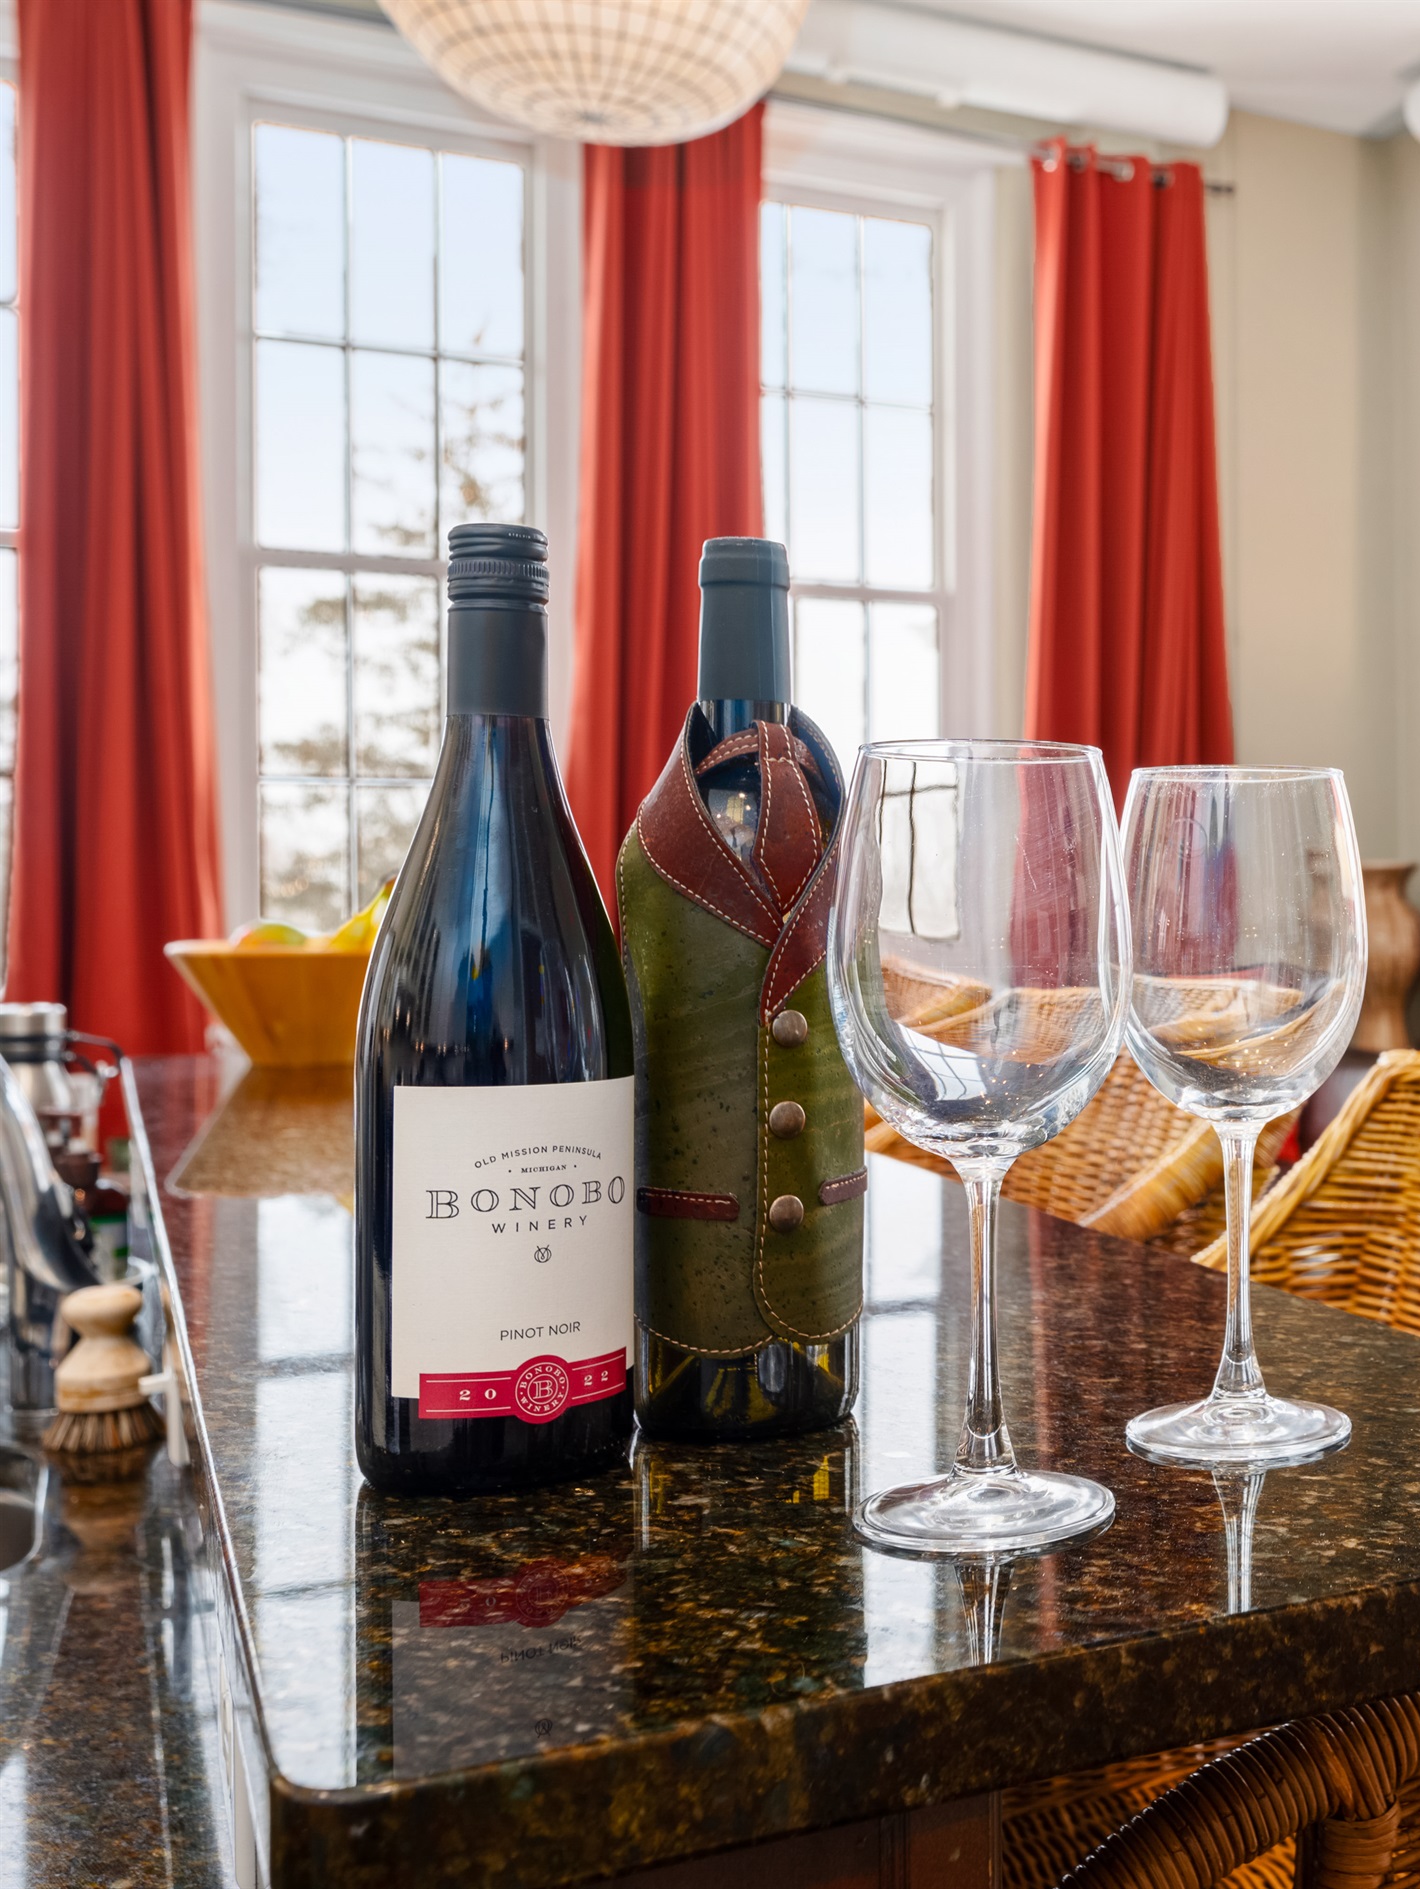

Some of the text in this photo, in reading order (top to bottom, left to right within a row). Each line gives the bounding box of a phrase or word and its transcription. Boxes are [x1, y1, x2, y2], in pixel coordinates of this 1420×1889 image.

[474, 1145, 602, 1169] OLD MISSION PENINSULA
[521, 1164, 567, 1174] MICHIGAN
[425, 1175, 626, 1219] BONOBO
[492, 1215, 588, 1234] WINERY
[500, 1321, 581, 1341] PINOT NOIR
[519, 1365, 566, 1389] BONOBO
[533, 1379, 554, 1400] B
[520, 1392, 564, 1412] WINERY
